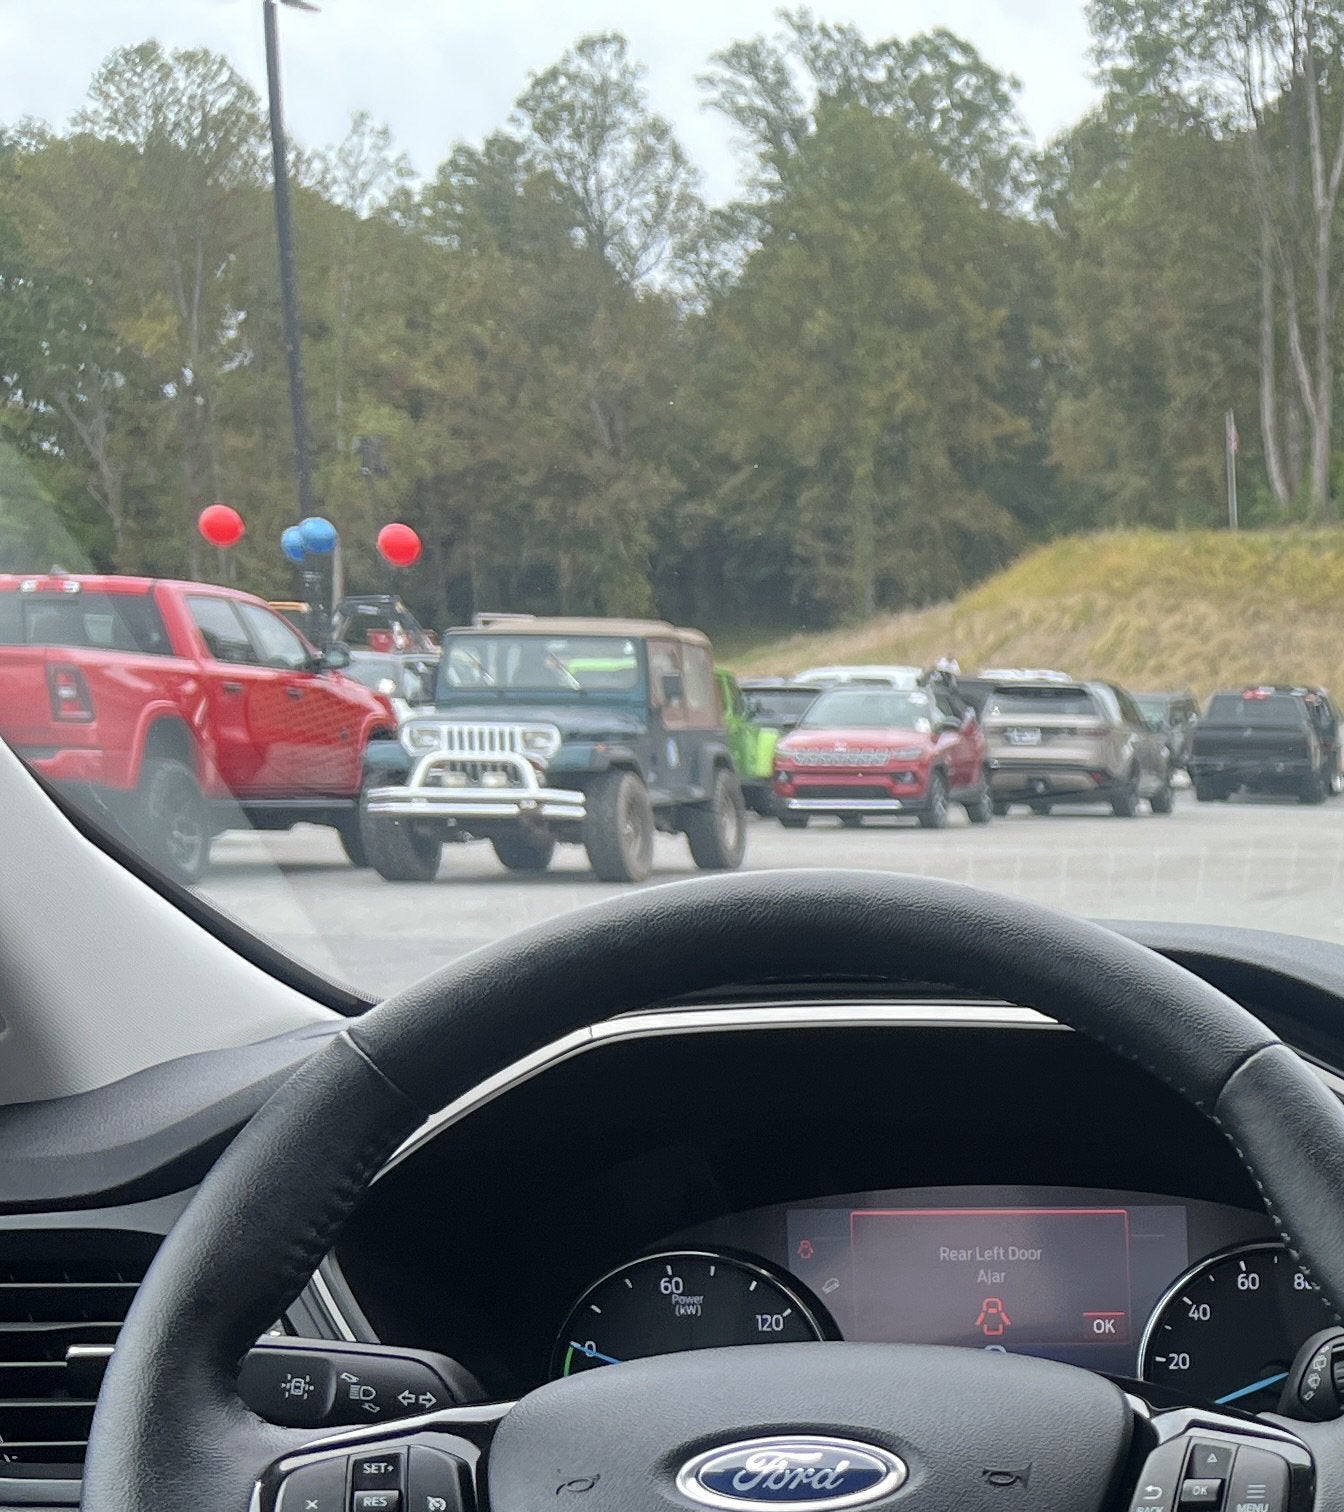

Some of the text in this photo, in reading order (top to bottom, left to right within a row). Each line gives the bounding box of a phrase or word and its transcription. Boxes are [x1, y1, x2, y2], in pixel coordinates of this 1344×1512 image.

[939, 1246, 1043, 1262] Rear Left Door
[660, 1276, 684, 1295] 60
[977, 1268, 1006, 1286] Ajar
[1236, 1273, 1260, 1290] 60
[671, 1294, 704, 1305] Power
[674, 1304, 702, 1317] (kW)
[1188, 1303, 1211, 1321] 40
[755, 1313, 785, 1332] 120
[1092, 1319, 1116, 1334] OK
[1168, 1352, 1191, 1370] 20
[732, 1451, 851, 1492] Ford
[1192, 1485, 1209, 1496] OK
[363, 1496, 388, 1507] RES
